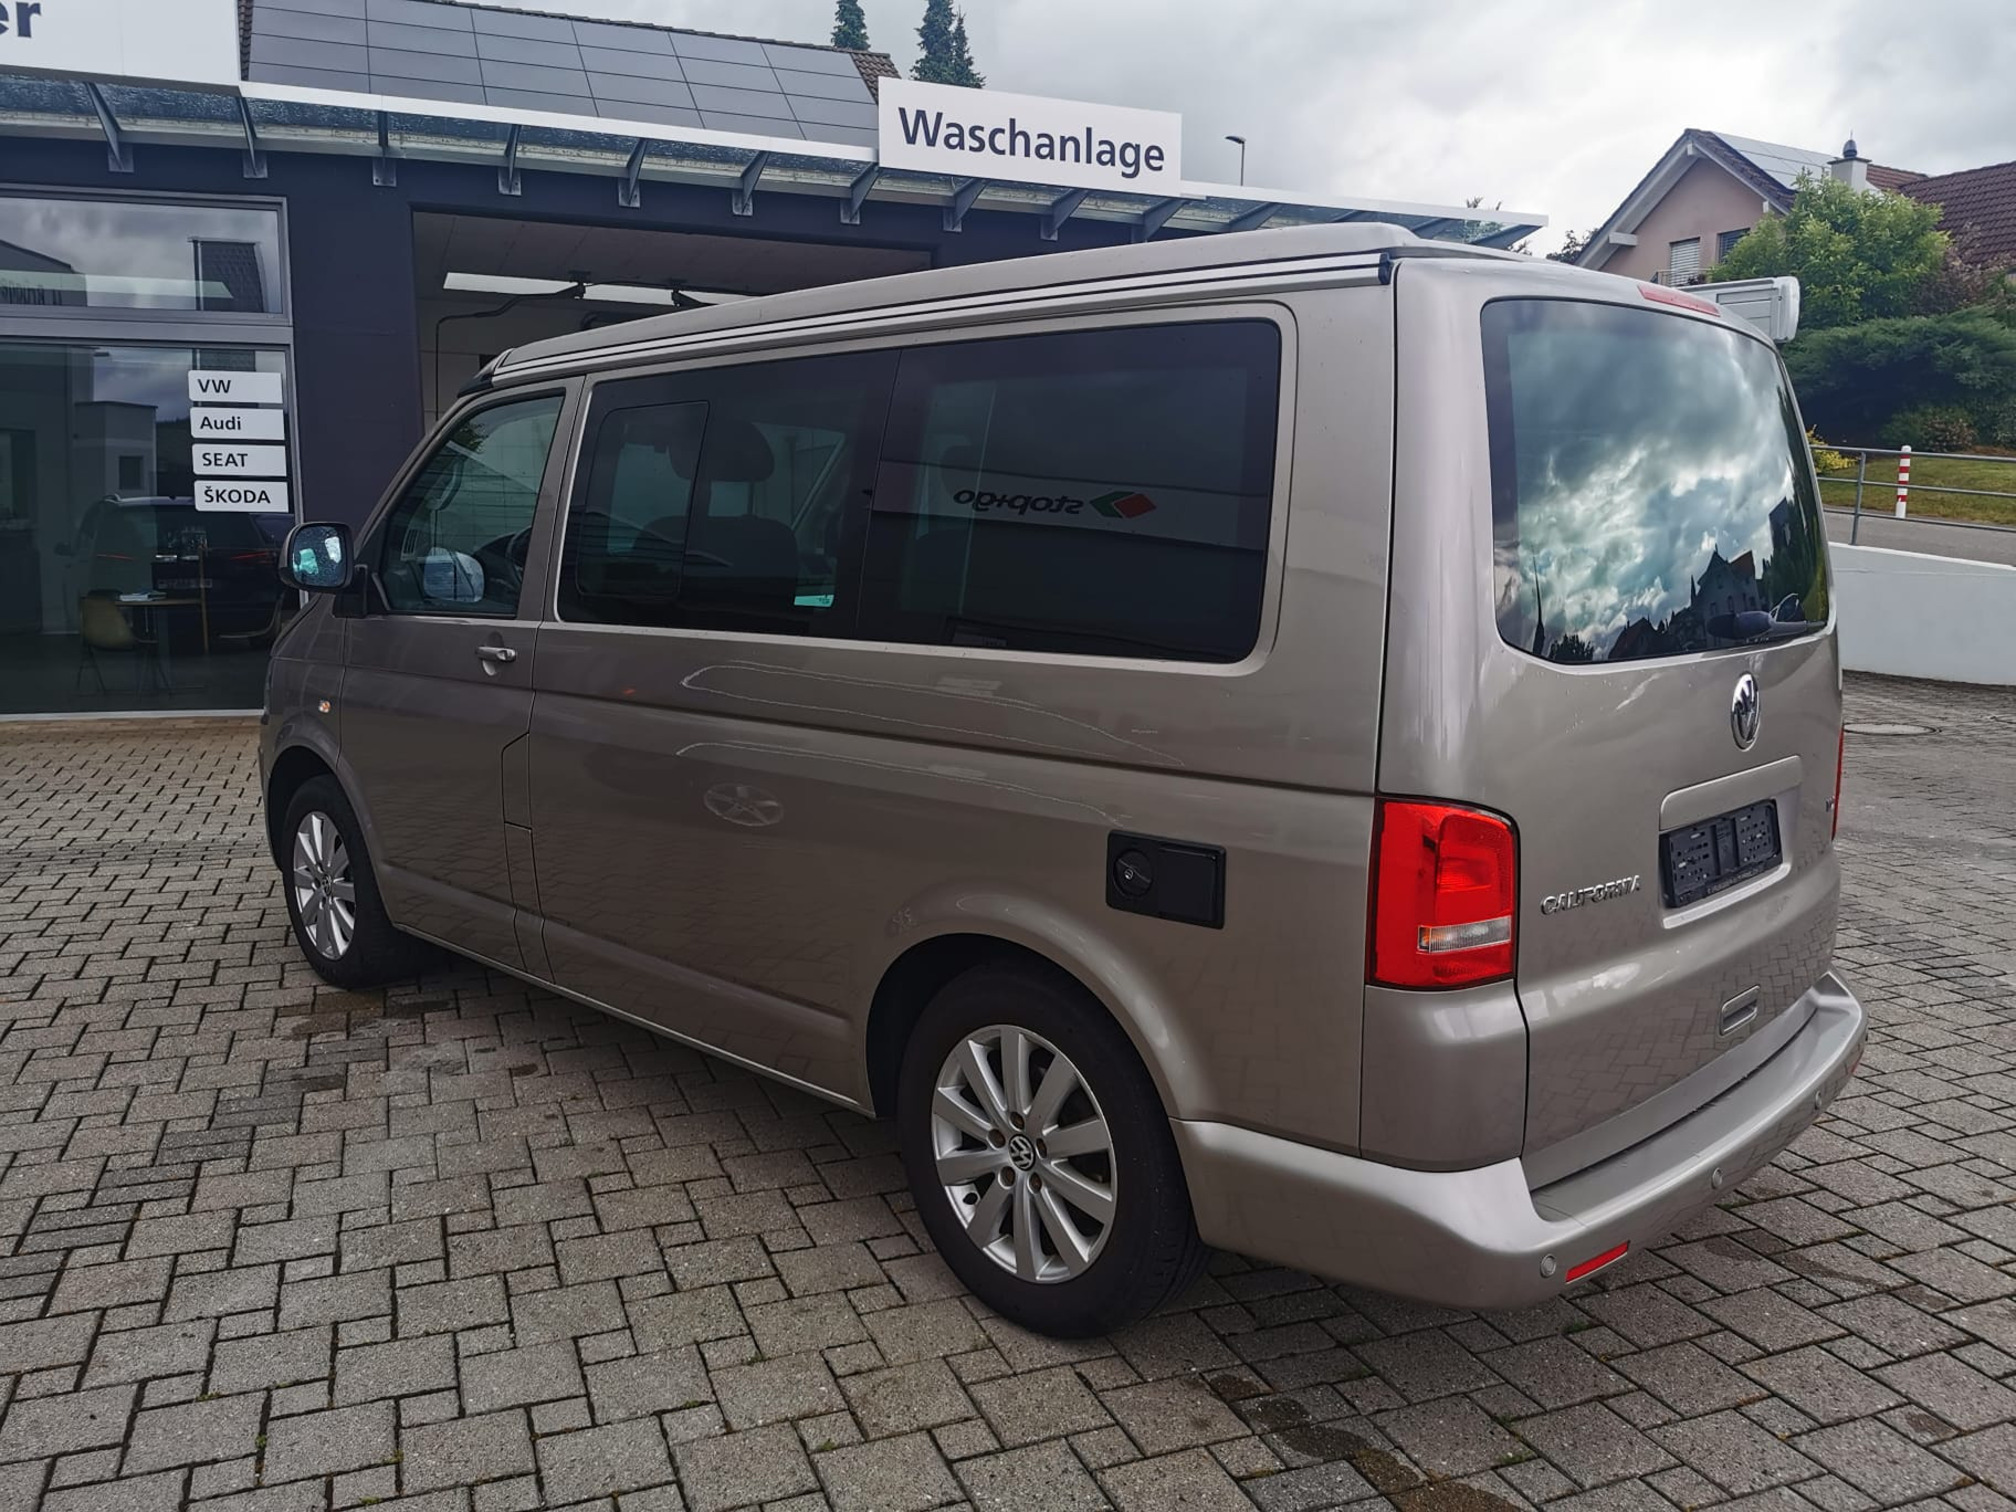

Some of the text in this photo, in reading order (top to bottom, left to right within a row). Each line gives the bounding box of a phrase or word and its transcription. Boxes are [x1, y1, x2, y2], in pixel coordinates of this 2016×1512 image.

[898, 106, 1165, 179] Waschanlage
[197, 378, 232, 394] VW
[200, 415, 242, 431] Audi
[201, 452, 248, 468] SEAT
[203, 485, 271, 504] ŠKODA
